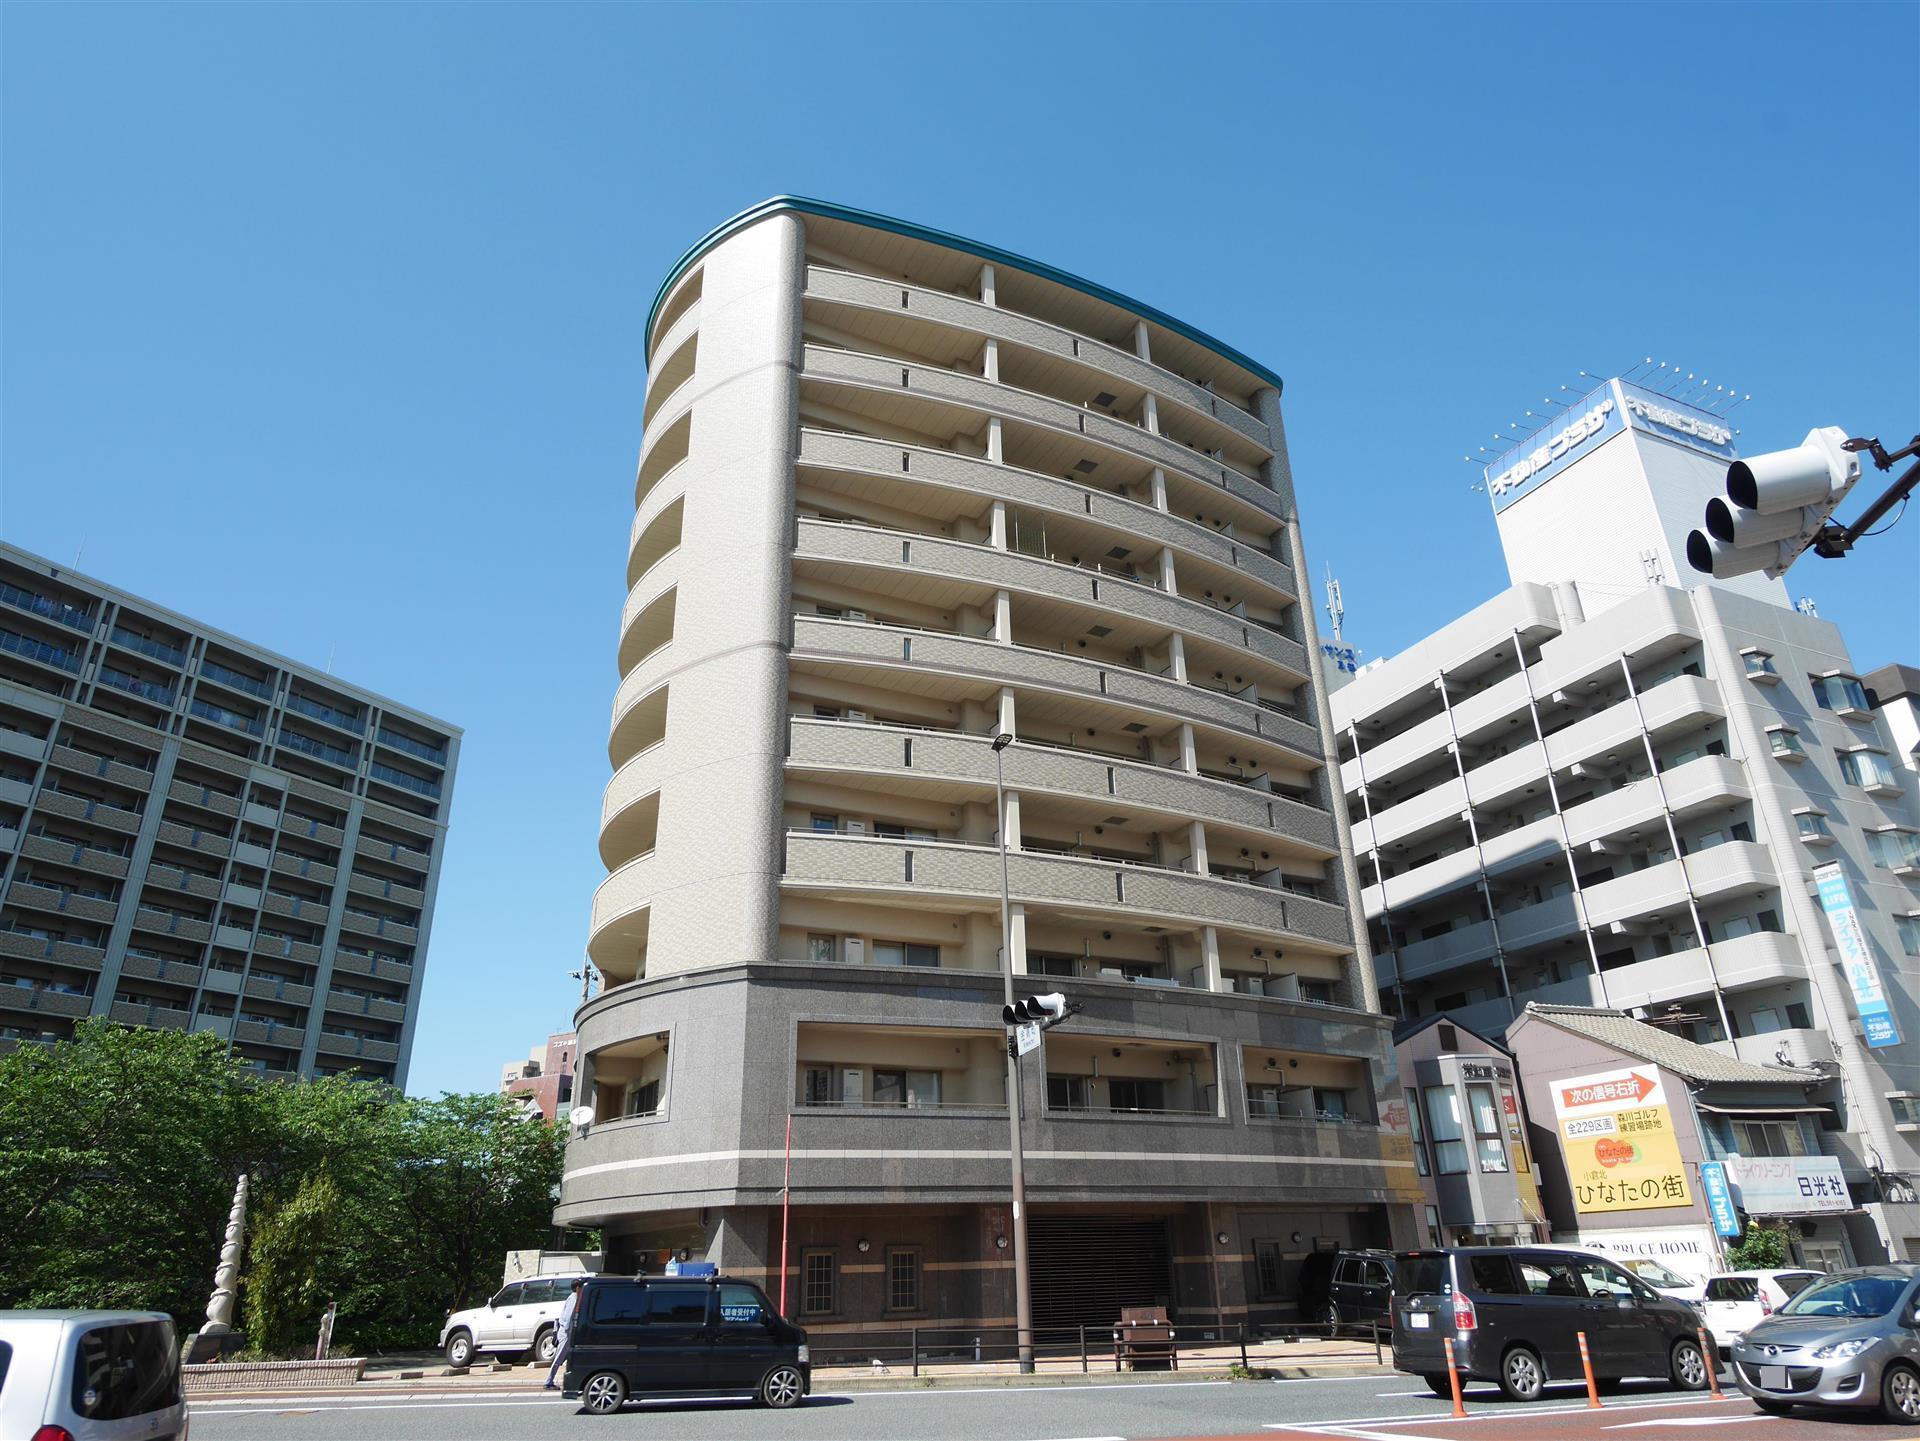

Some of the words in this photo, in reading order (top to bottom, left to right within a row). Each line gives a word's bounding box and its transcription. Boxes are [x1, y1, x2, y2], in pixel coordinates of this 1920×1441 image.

[1625, 396, 1732, 446] 不動産プラザ
[1491, 398, 1614, 495] 不動産プラザ
[1571, 1079, 1640, 1104] 次の信号右折
[1617, 1108, 1659, 1122] 森川ゴルフ
[1567, 1118, 1613, 1136] 全229区画
[1618, 1120, 1663, 1133] 練習場跡地
[1583, 1169, 1608, 1181] 小倉北
[1575, 1175, 1685, 1205] ひなたの街
[1797, 1175, 1845, 1197] 日光社
[1660, 1240, 1703, 1255] HOME
